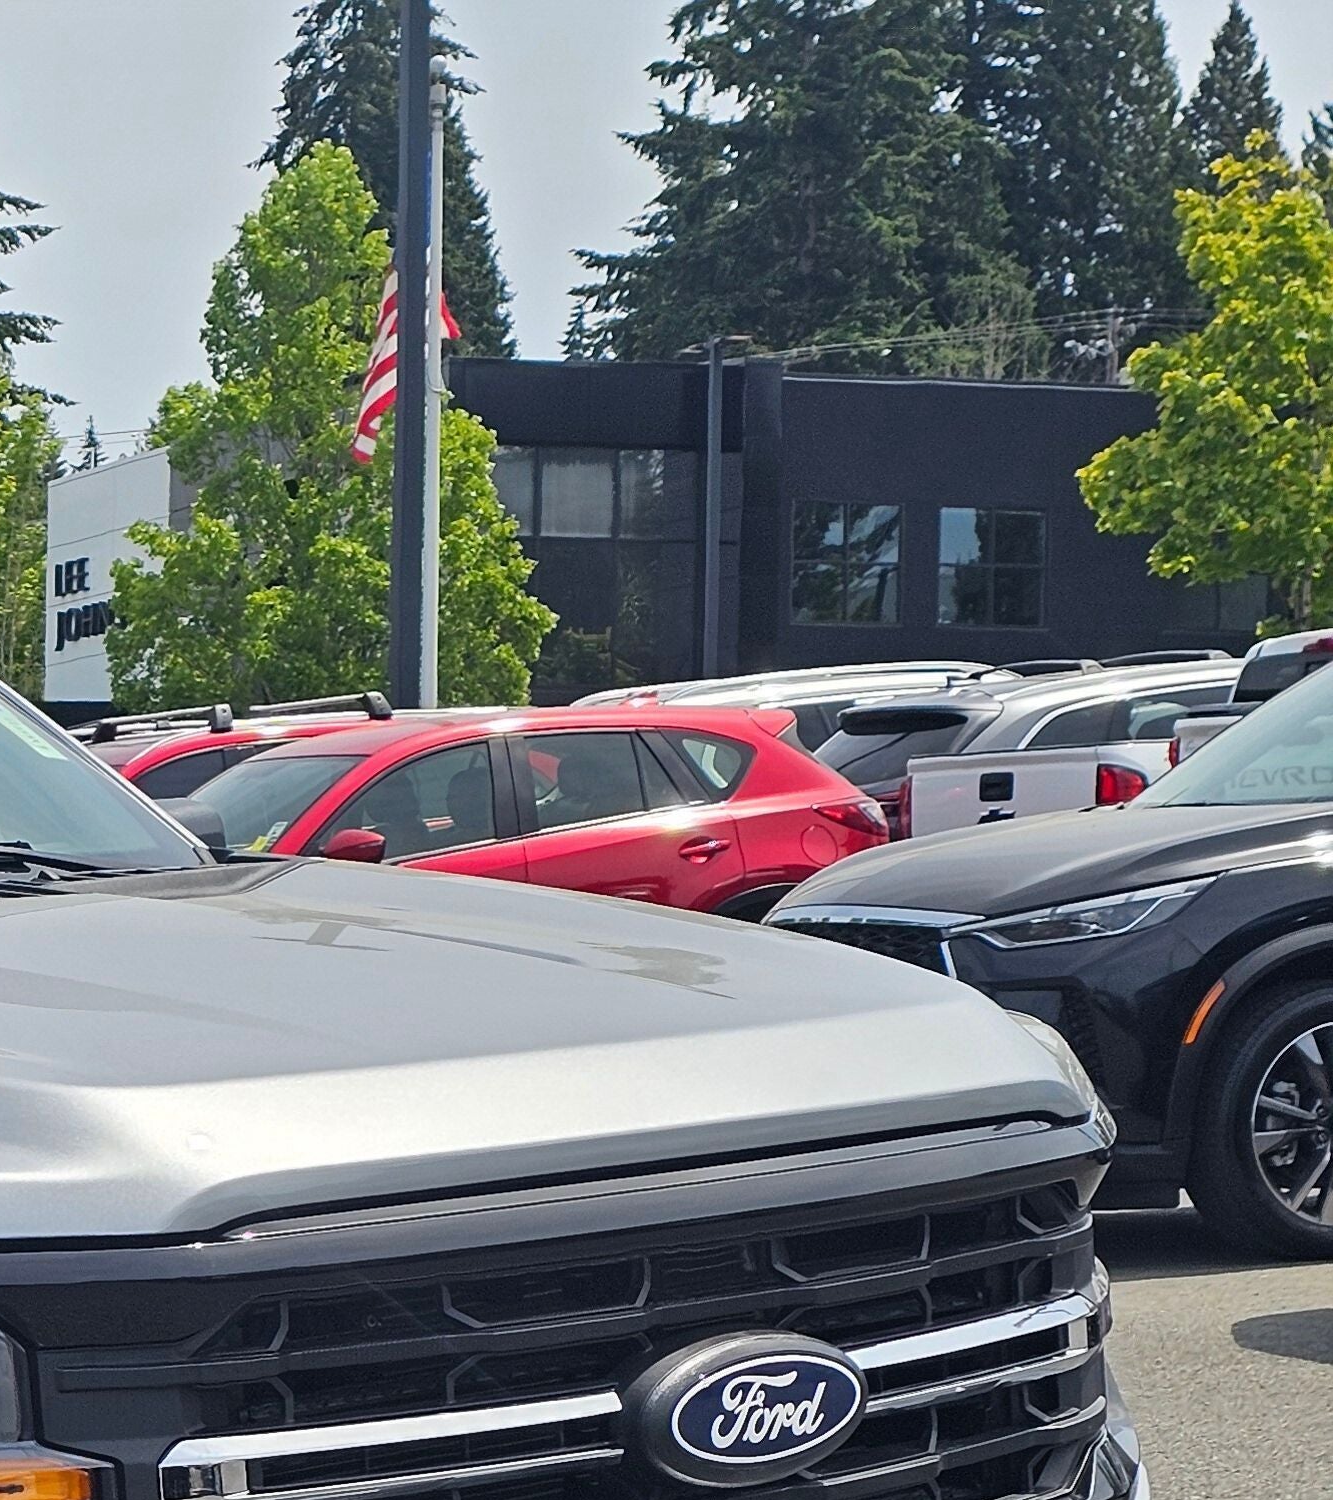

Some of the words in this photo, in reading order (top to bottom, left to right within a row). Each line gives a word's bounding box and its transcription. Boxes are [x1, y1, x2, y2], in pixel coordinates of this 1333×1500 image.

[54, 557, 90, 597] LEE
[54, 599, 116, 651] JOHN
[710, 1370, 828, 1449] Ford
